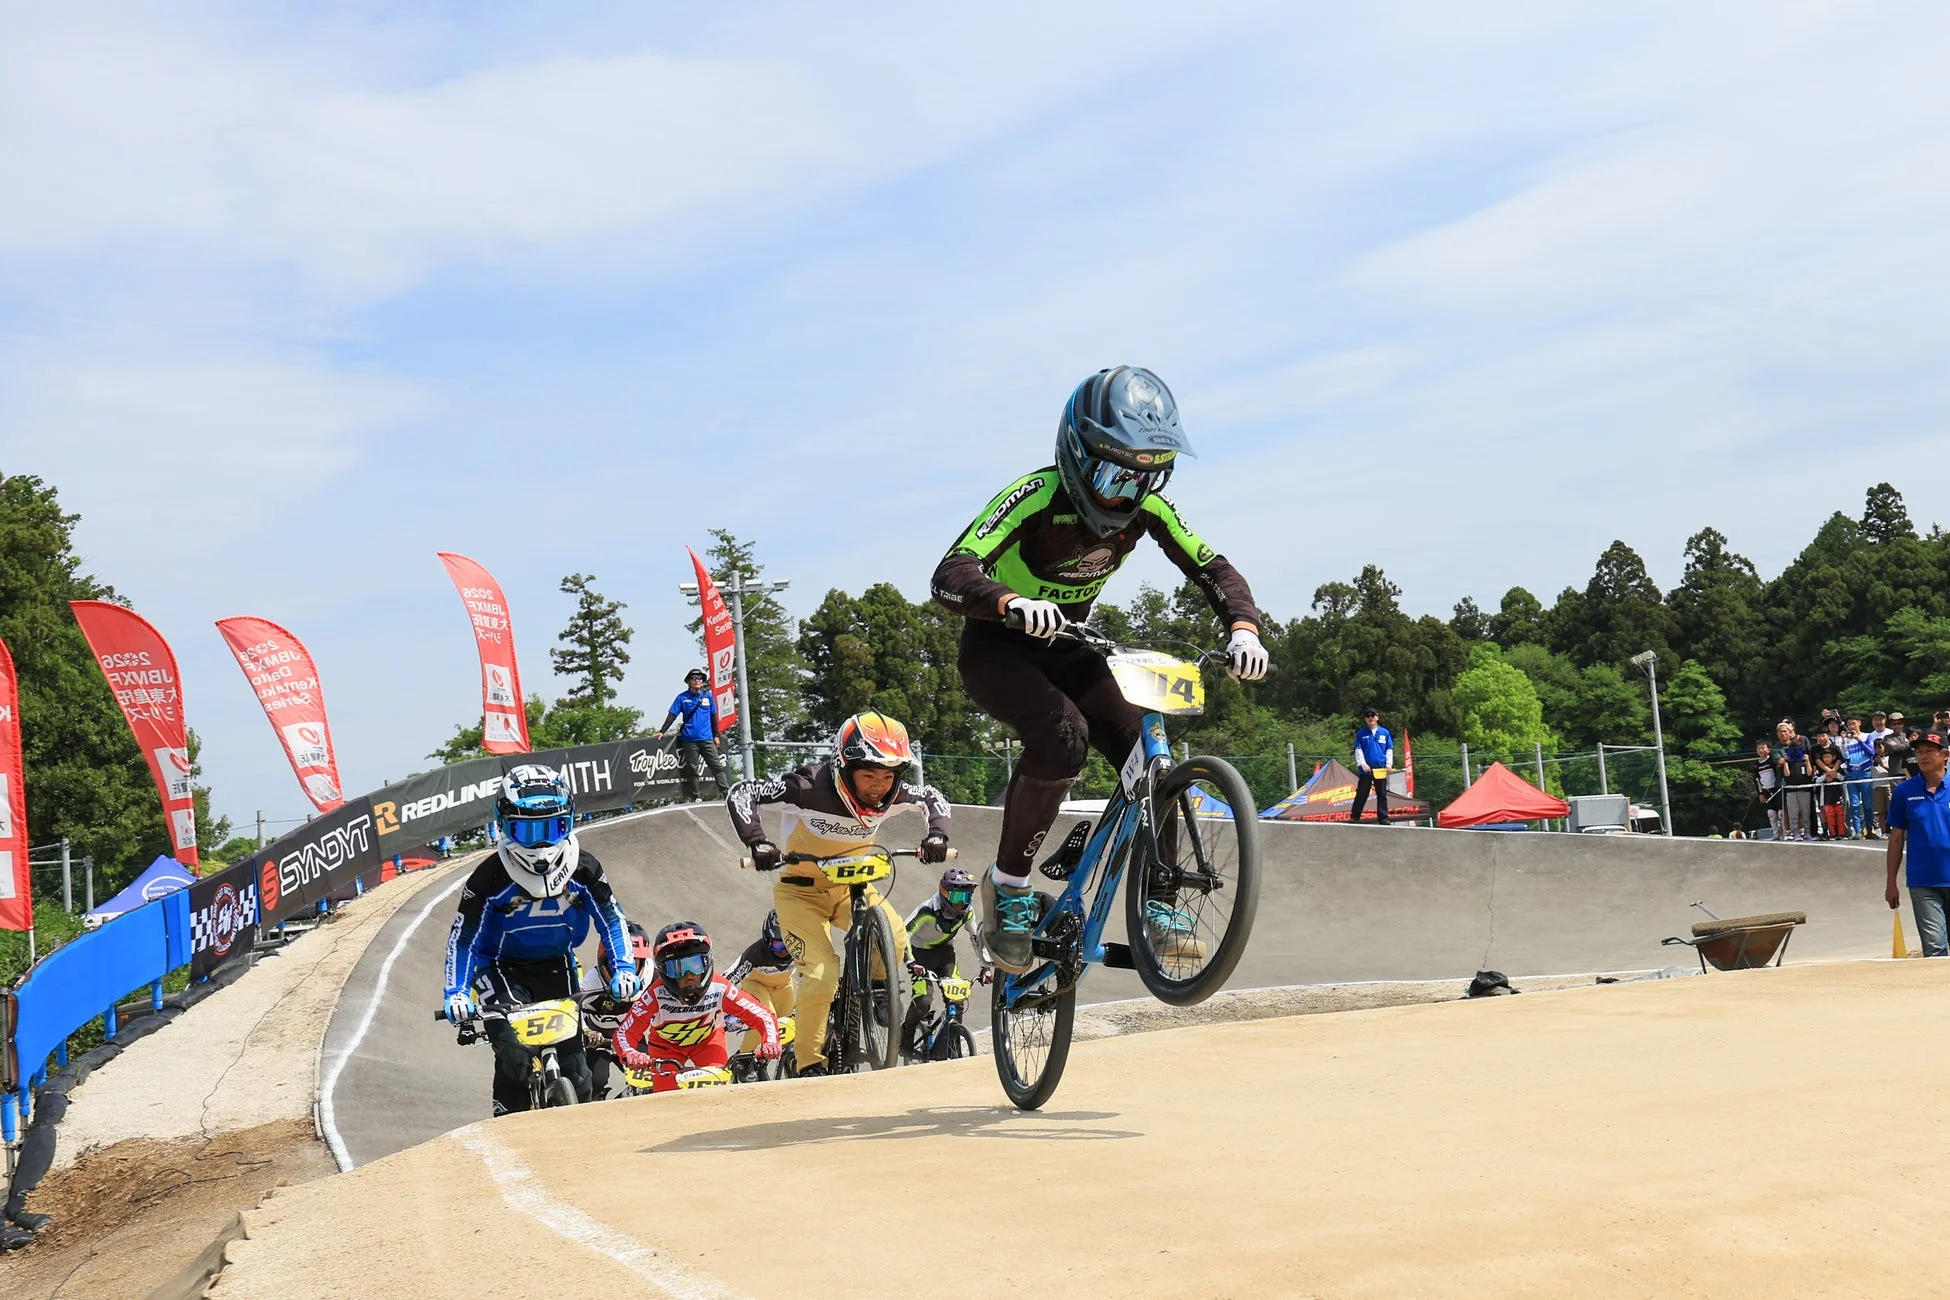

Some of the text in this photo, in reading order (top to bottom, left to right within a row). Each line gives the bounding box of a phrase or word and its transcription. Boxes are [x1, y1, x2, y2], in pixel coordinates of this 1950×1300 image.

[629, 748, 656, 779] Troy
[401, 776, 503, 823] REDLINE
[279, 813, 371, 897] SYNDYT
[836, 865, 875, 878] 64
[945, 984, 968, 997] 104
[526, 1014, 564, 1037] 54
